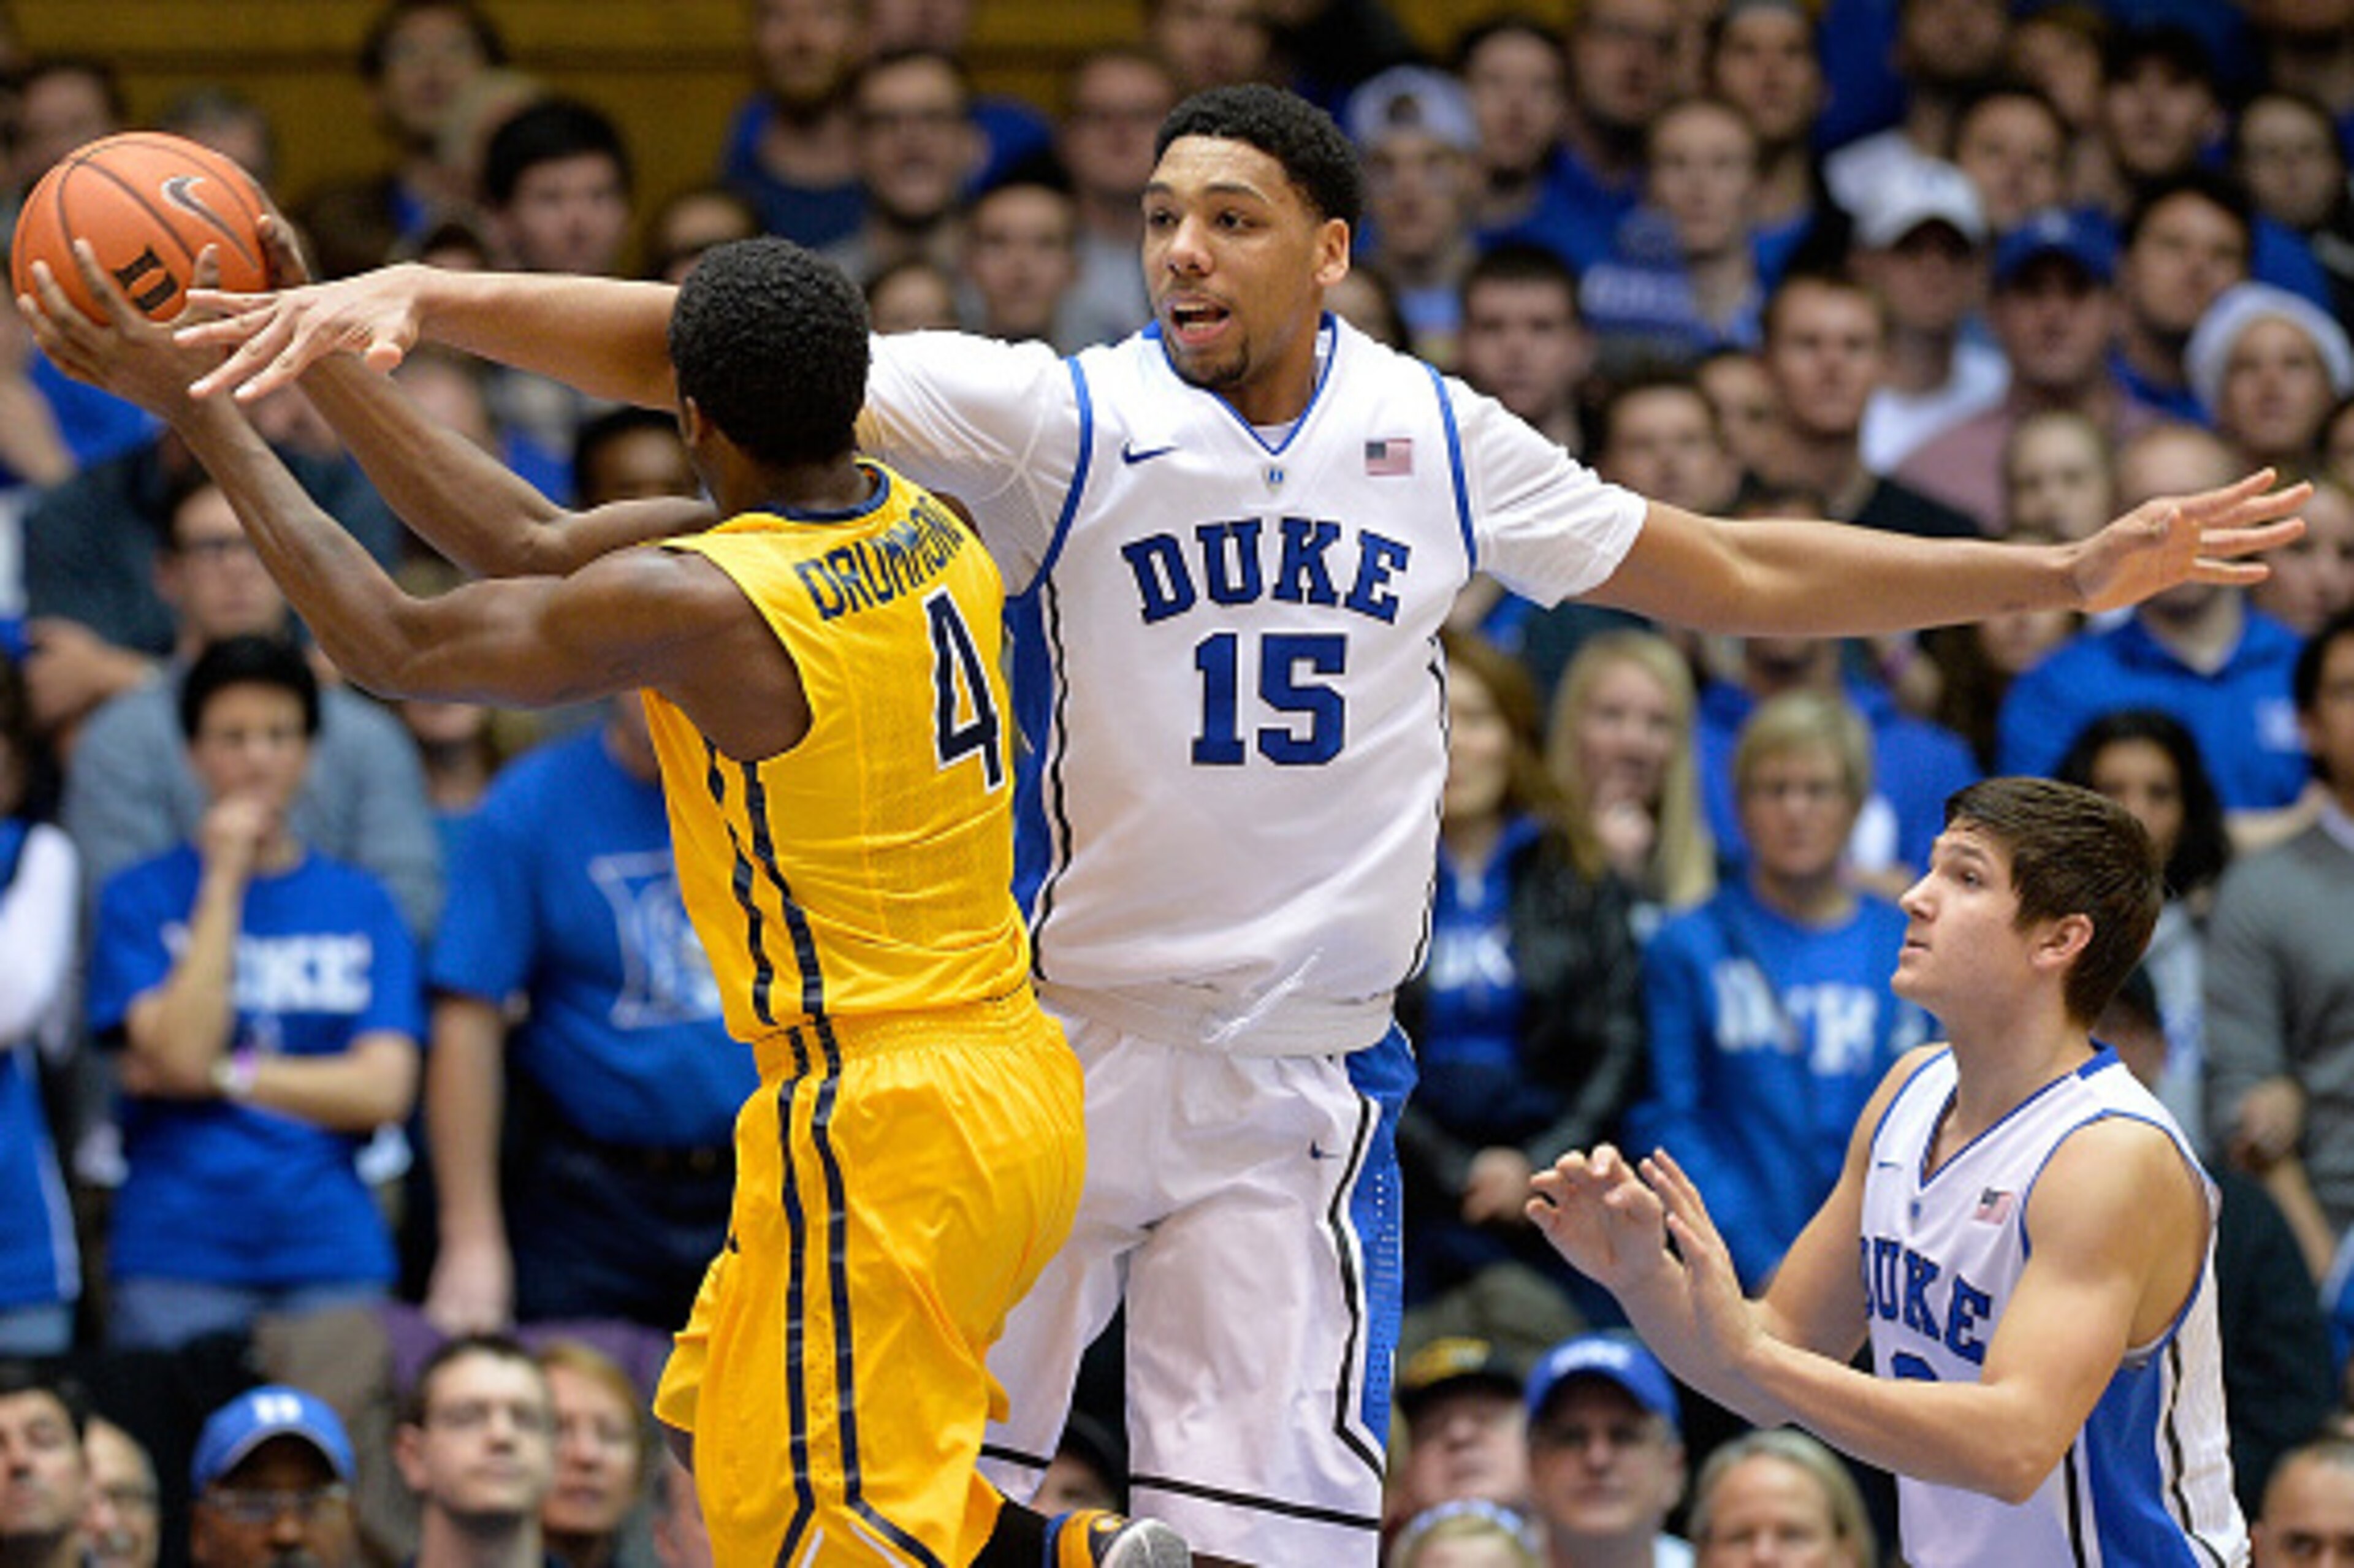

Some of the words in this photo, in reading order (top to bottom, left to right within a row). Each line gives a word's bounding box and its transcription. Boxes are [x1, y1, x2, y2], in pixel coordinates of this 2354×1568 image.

[793, 495, 965, 622] DRUMMON
[1121, 516, 1411, 625] DUKE
[923, 582, 1006, 795] 4
[1191, 633, 1347, 766] 15
